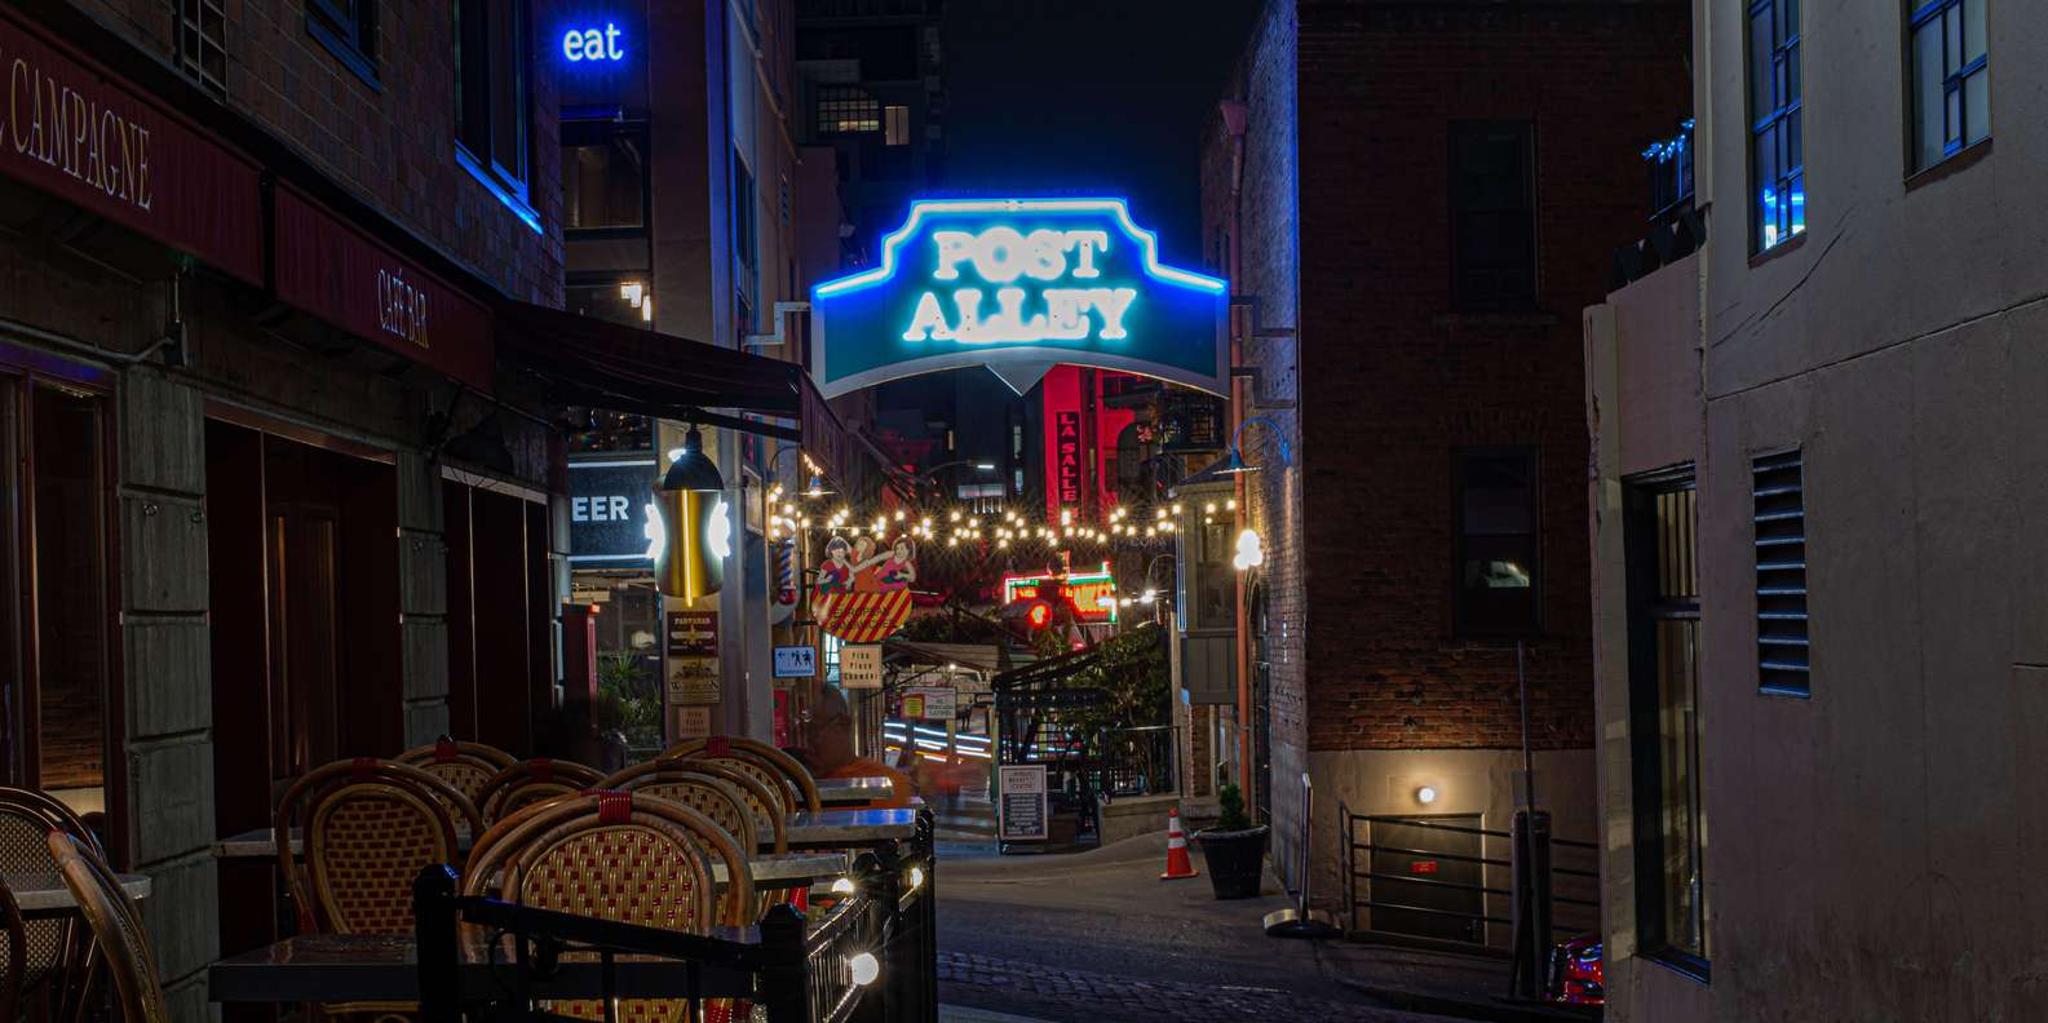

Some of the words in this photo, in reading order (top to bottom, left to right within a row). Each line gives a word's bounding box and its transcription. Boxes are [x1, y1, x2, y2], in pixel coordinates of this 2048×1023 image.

[563, 23, 624, 61] eat
[11, 58, 151, 213] CAMPAGNE
[933, 226, 1109, 282] POST
[378, 268, 406, 336] CAFÉ
[406, 284, 430, 349] BAR
[903, 288, 1137, 343] ALLEY
[1060, 413, 1076, 437] LA
[1061, 442, 1078, 502] SALLE
